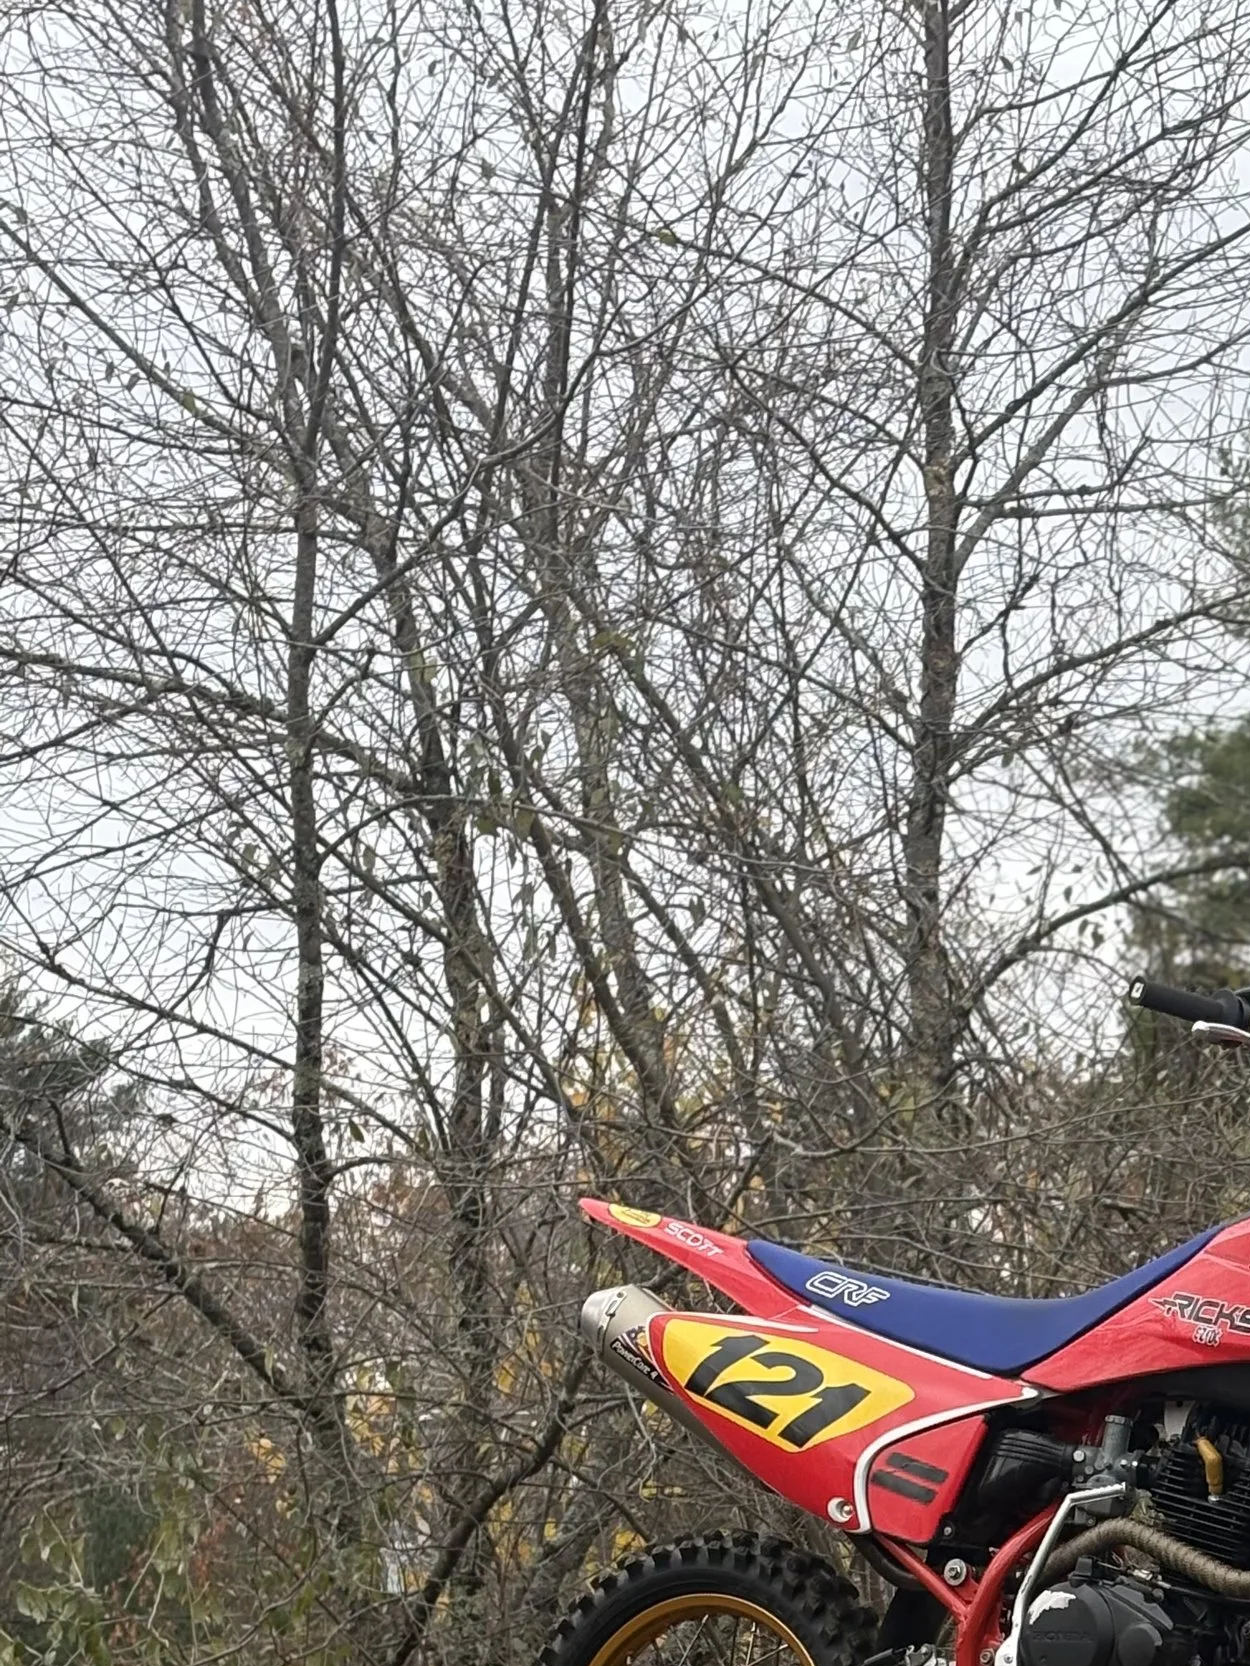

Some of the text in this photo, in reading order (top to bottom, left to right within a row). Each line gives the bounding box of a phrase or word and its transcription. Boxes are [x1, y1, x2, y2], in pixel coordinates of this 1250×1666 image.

[664, 1221, 724, 1257] SCOTT
[805, 1270, 891, 1307] CRF
[684, 1335, 872, 1448] 121
